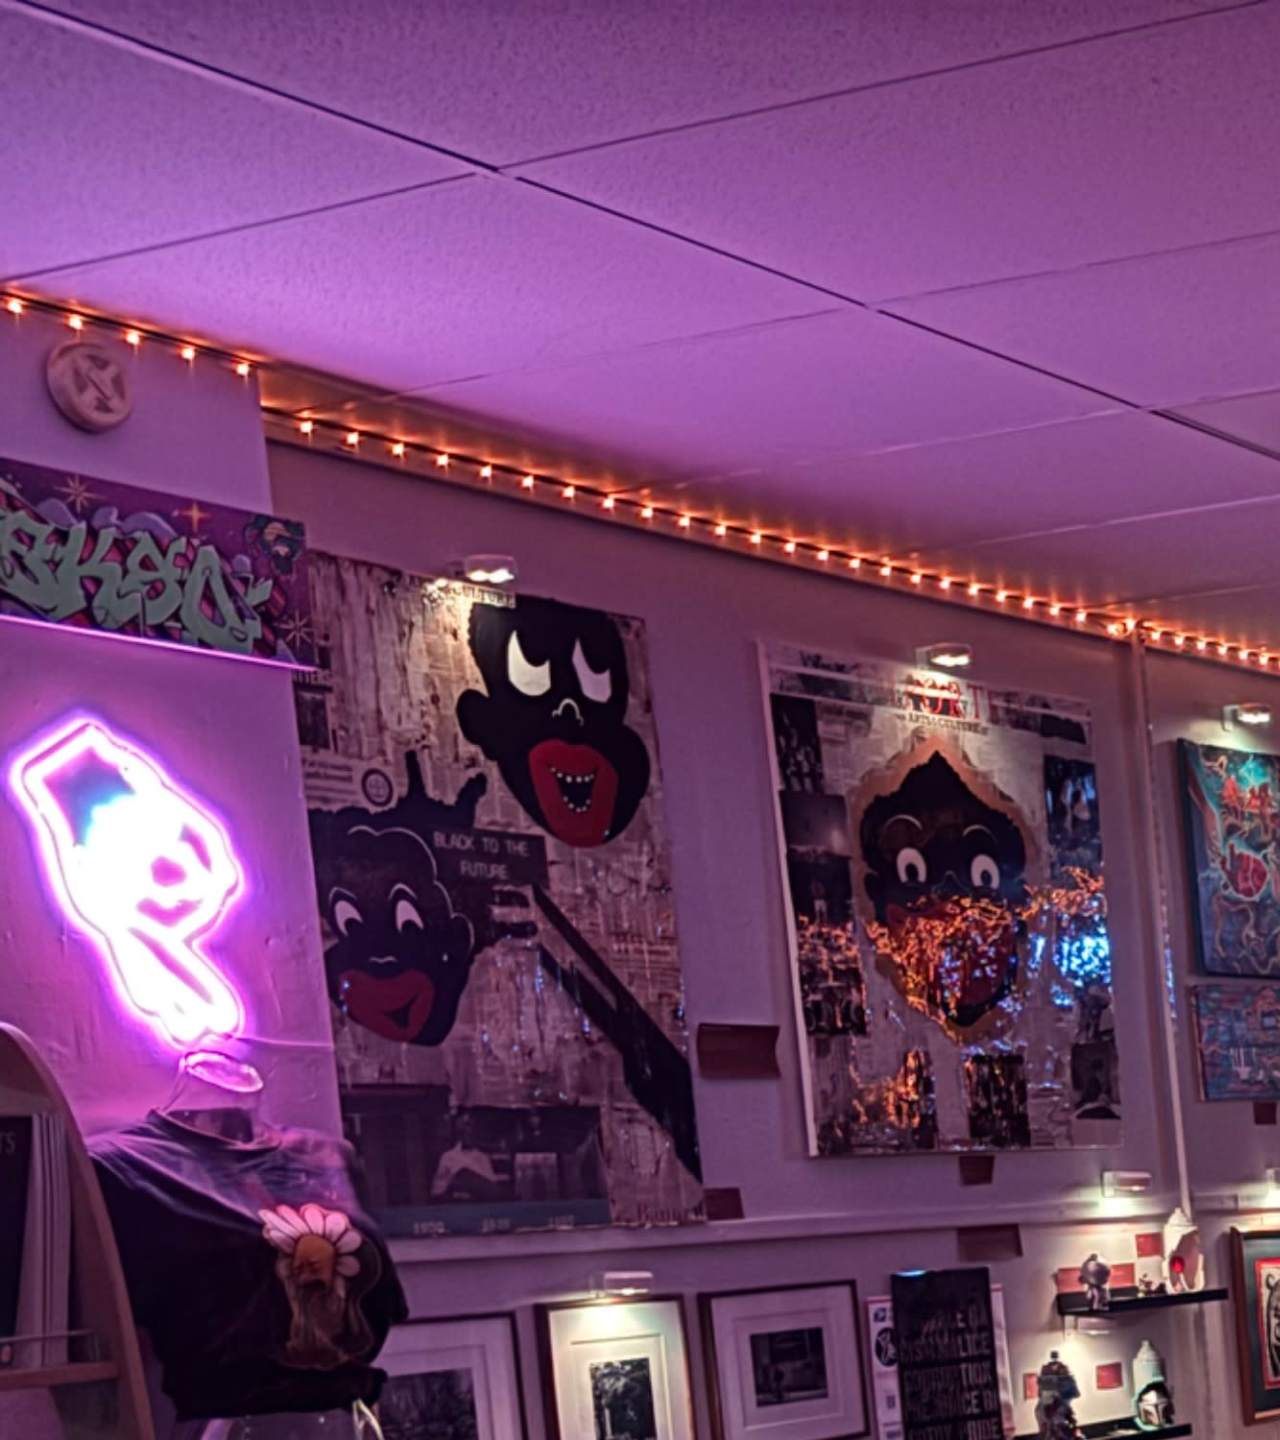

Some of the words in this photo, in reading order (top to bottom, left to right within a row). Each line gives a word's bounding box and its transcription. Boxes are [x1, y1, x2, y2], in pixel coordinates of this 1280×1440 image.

[433, 831, 473, 849] BLACK
[483, 837, 498, 853] TO
[506, 839, 528, 856] THE
[460, 860, 508, 879] FUTURE
